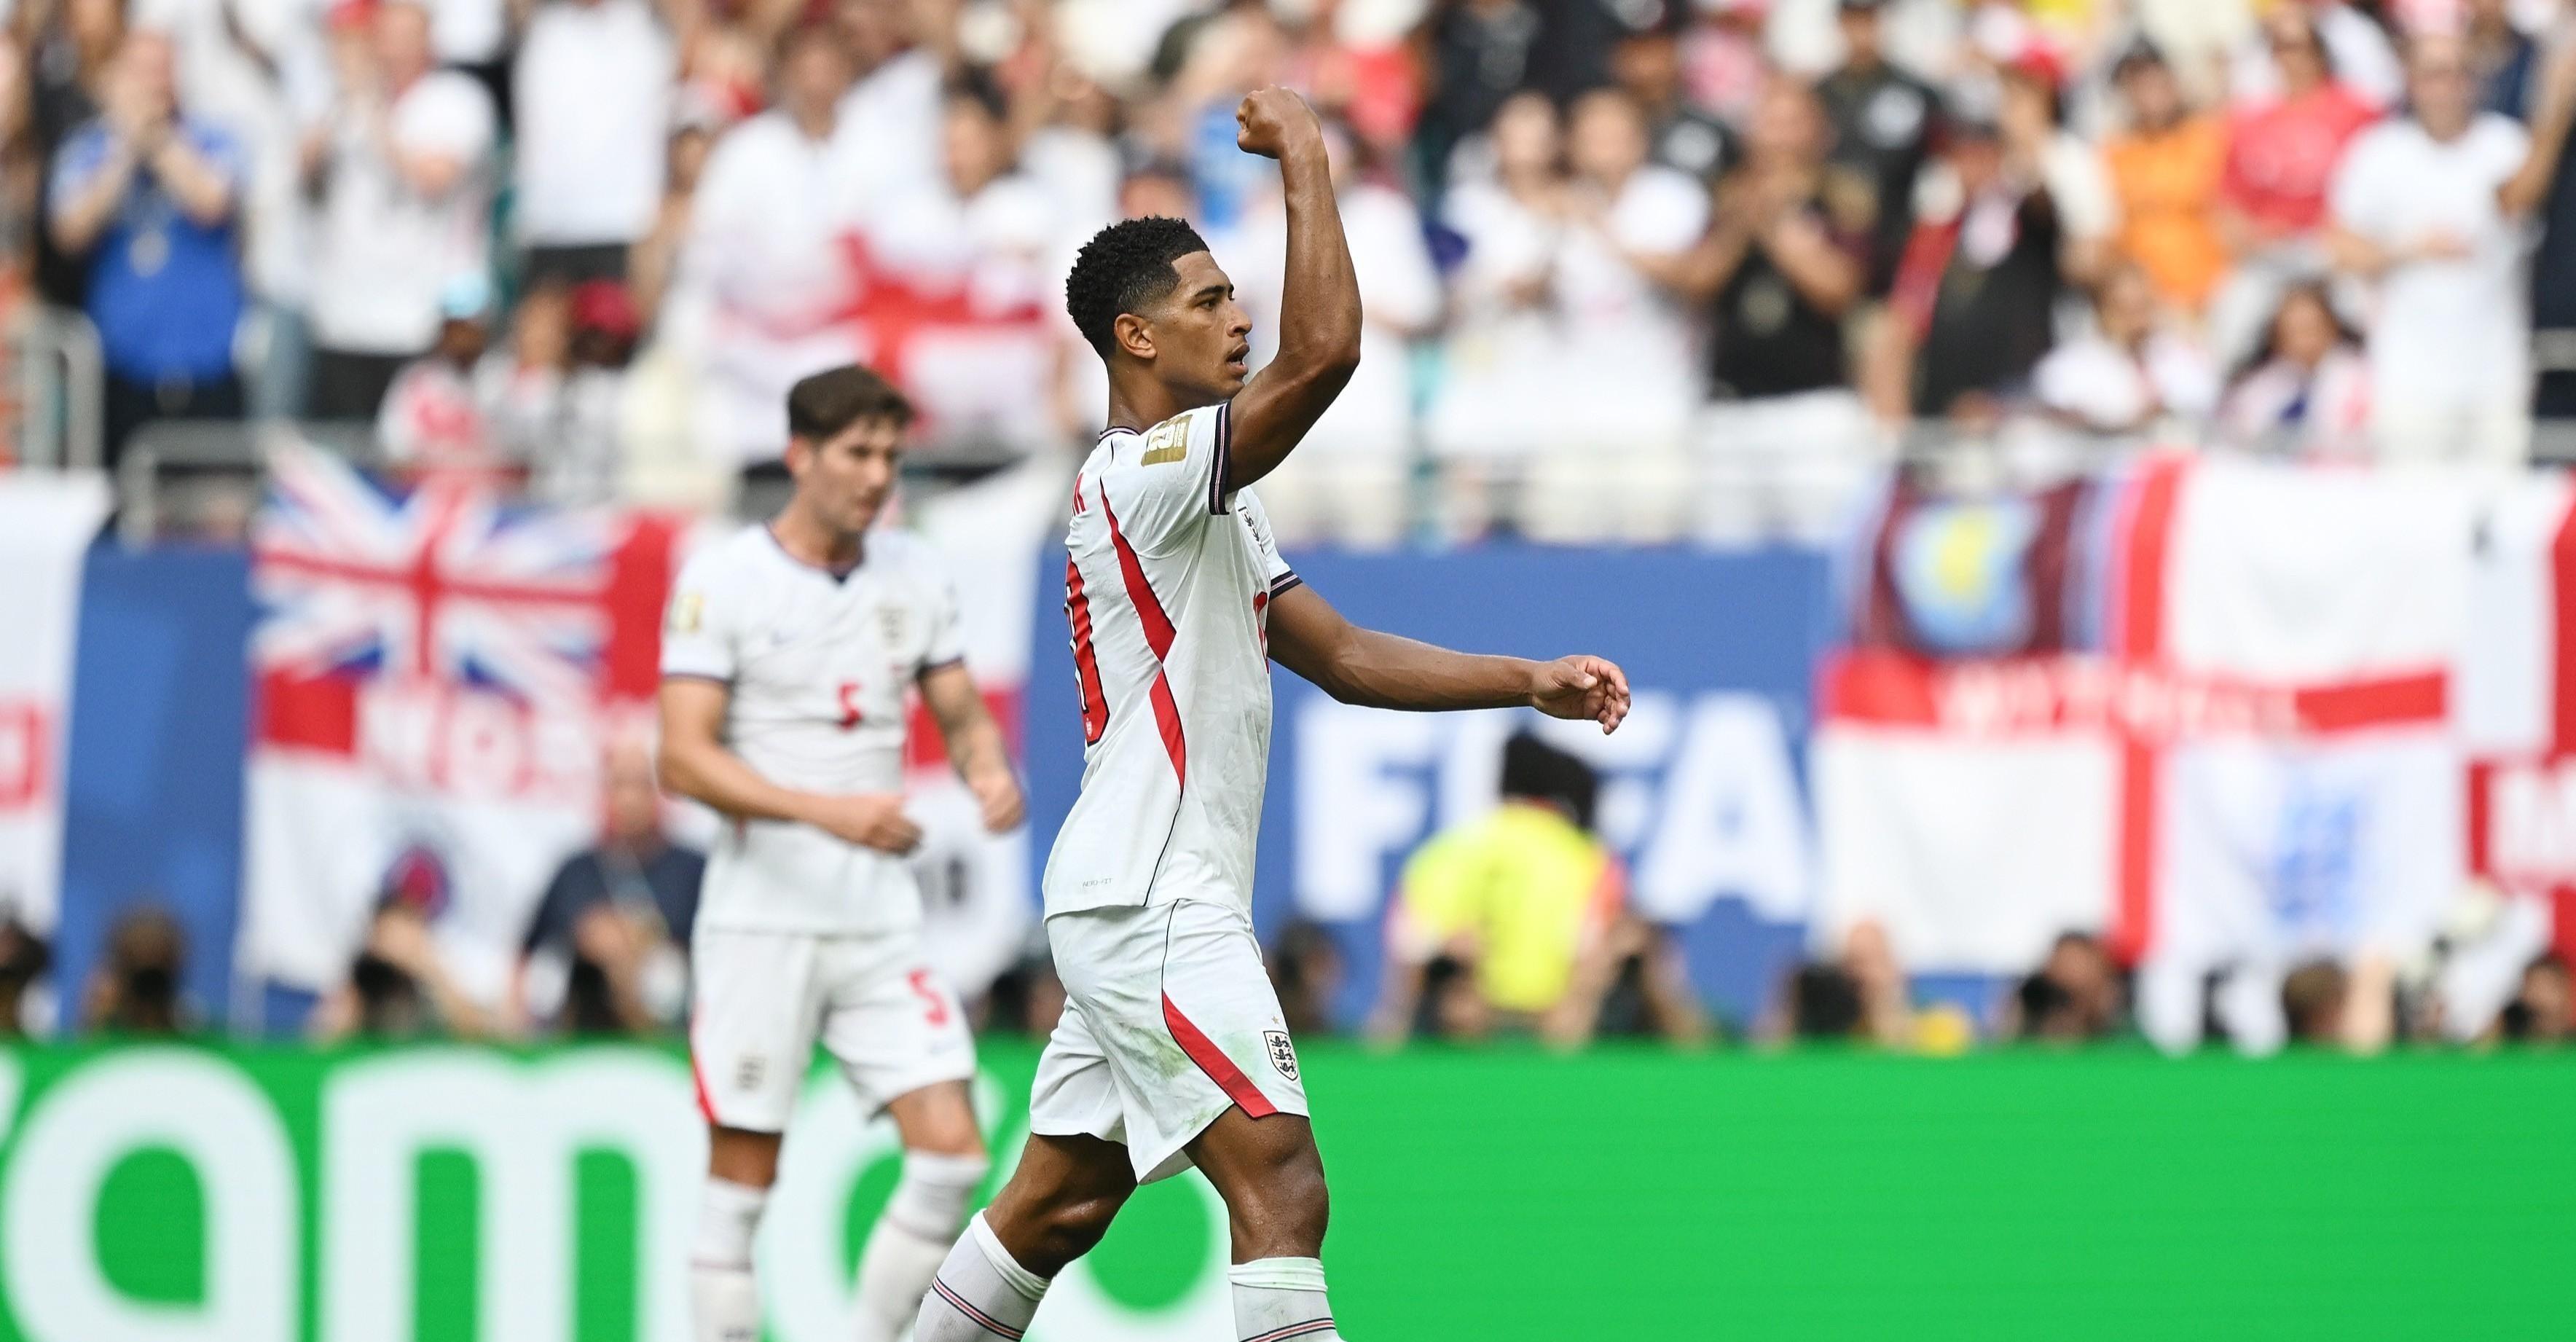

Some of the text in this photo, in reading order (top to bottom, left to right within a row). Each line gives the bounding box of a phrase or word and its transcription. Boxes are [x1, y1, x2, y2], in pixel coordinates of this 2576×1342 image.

[836, 680, 863, 734] 5
[907, 966, 949, 1028] 5
[0, 1040, 1231, 1342] amco
